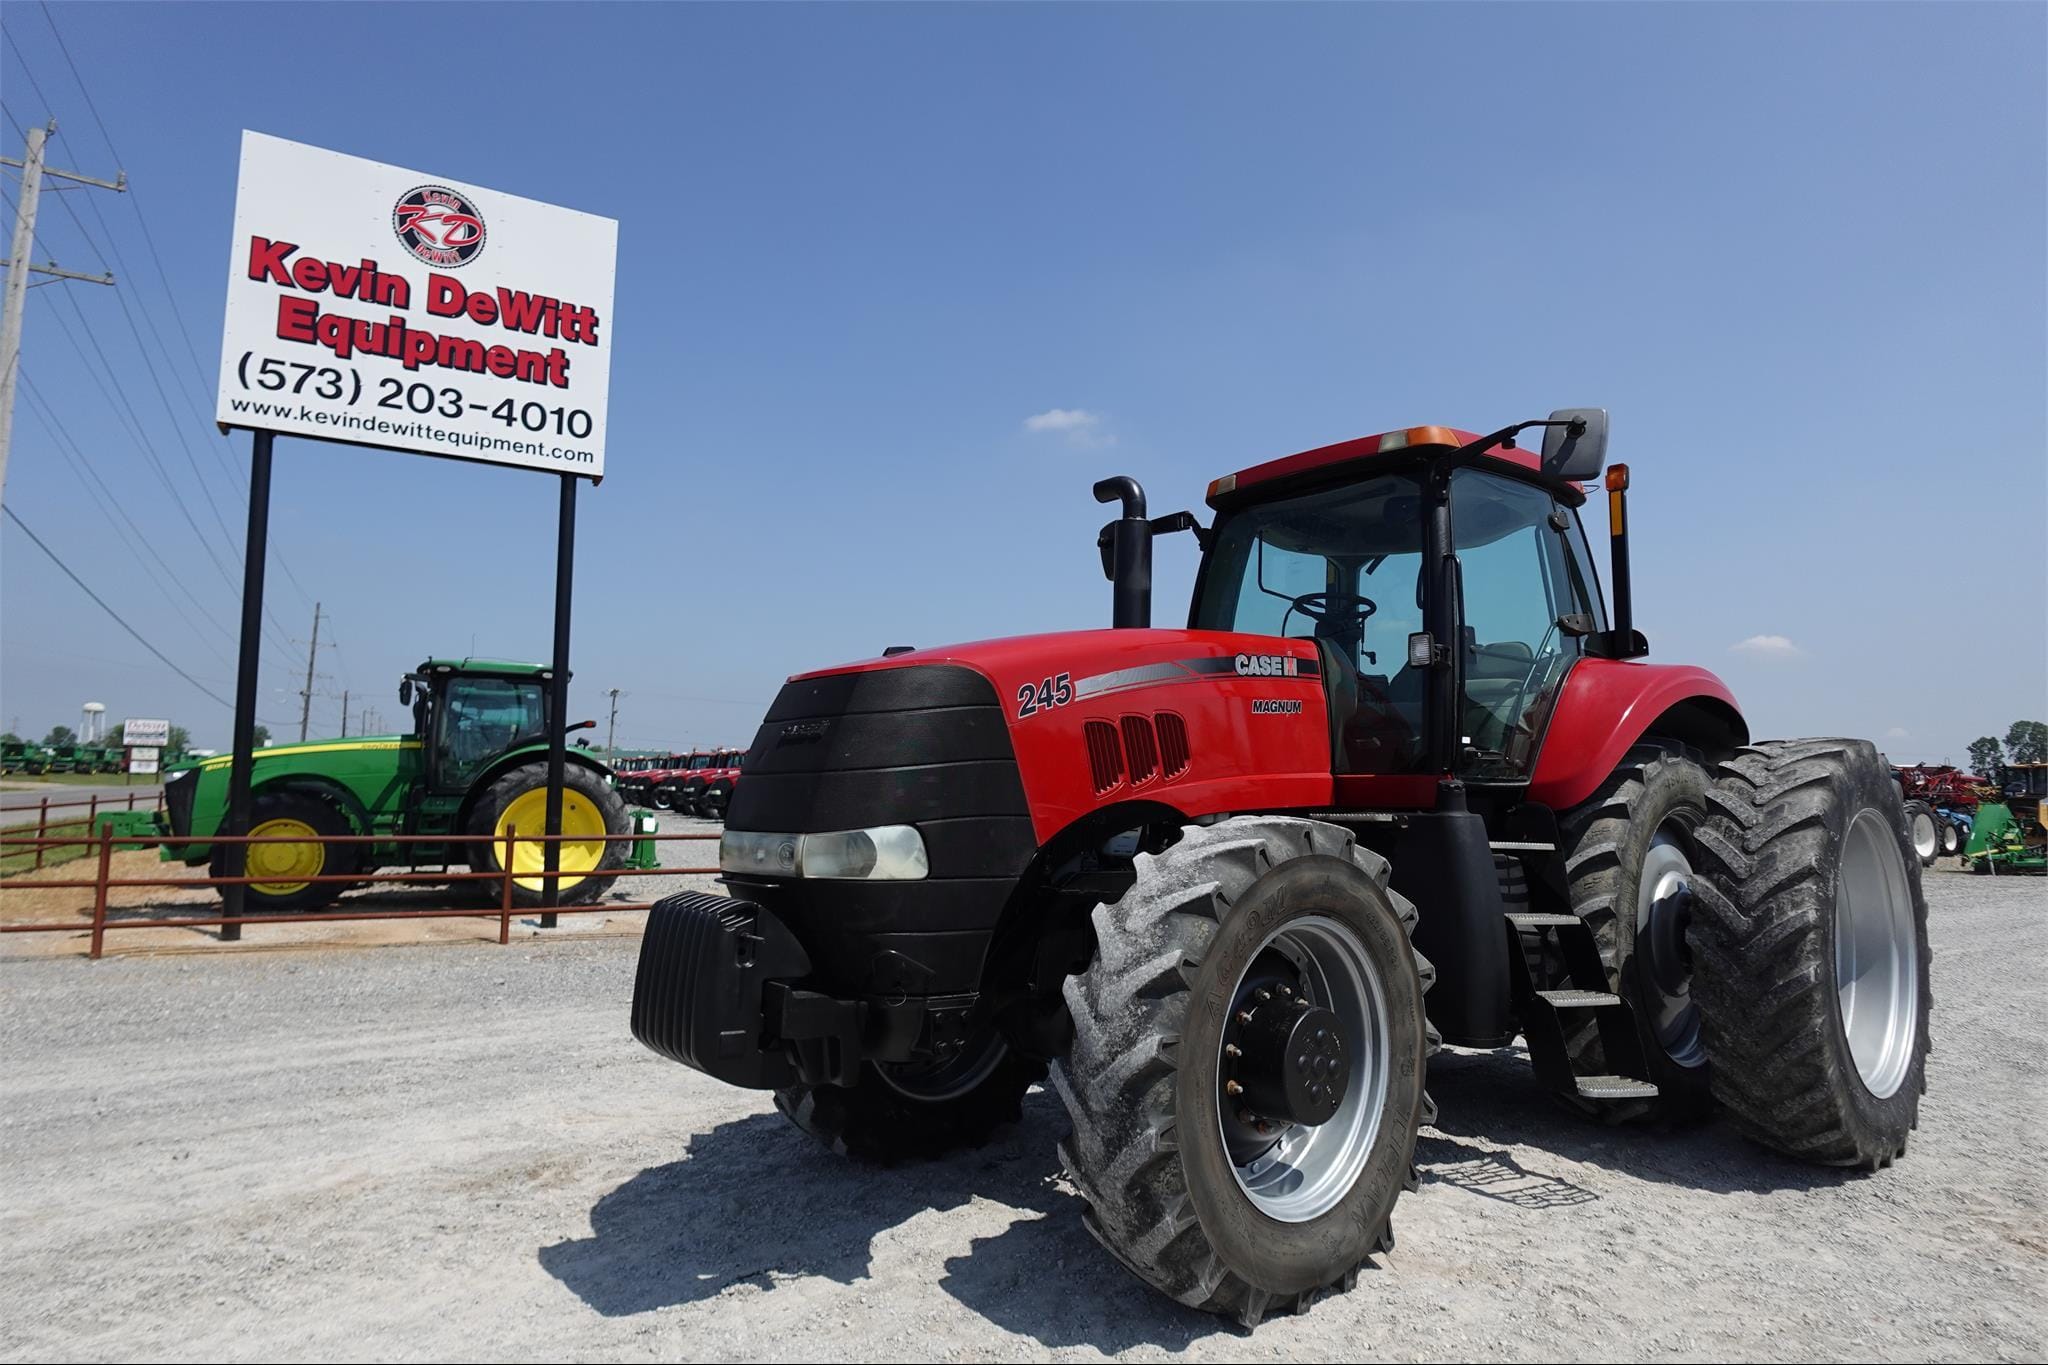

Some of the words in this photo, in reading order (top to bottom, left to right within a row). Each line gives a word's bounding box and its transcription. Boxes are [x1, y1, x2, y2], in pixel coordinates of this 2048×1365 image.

[421, 191, 462, 210] Kevin
[415, 243, 462, 264] DeWitt
[248, 235, 410, 309] Kevin
[427, 272, 600, 346] DeWitt
[276, 294, 571, 388] Equipment
[238, 351, 362, 406] (573)
[377, 377, 593, 439] 203-4010
[231, 398, 594, 463] www.kevindewittequipment.com
[1017, 672, 1073, 718] 245
[1252, 699, 1302, 714] MAGNUM
